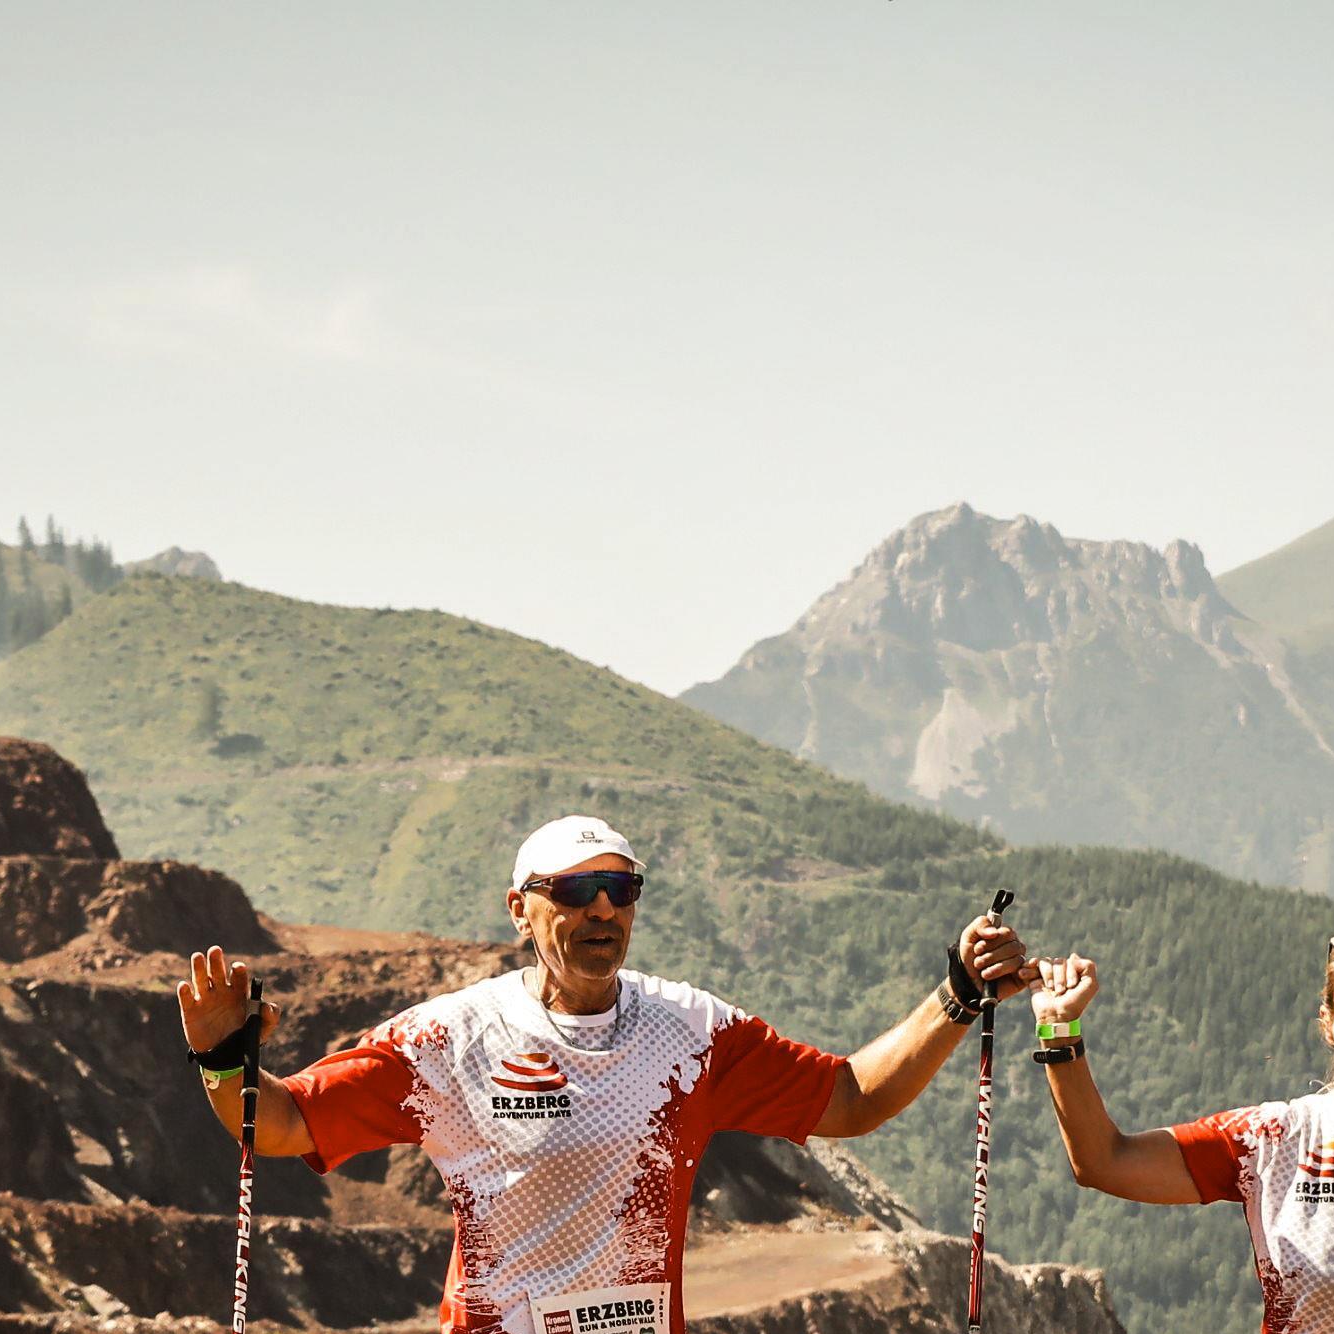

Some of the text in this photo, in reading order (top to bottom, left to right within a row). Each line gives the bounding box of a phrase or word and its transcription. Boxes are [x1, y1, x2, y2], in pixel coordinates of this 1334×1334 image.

[491, 1094, 571, 1110] ERZBERG
[492, 1109, 572, 1119] ADVENTURE DAYS
[973, 1085, 992, 1234] WALKING
[233, 1178, 253, 1334] WALKING
[576, 1299, 655, 1324] ERZBERG
[545, 1315, 570, 1325] Kronen
[579, 1316, 656, 1333] RUN & NORDIC WALK
[547, 1324, 572, 1334] Zeitung
